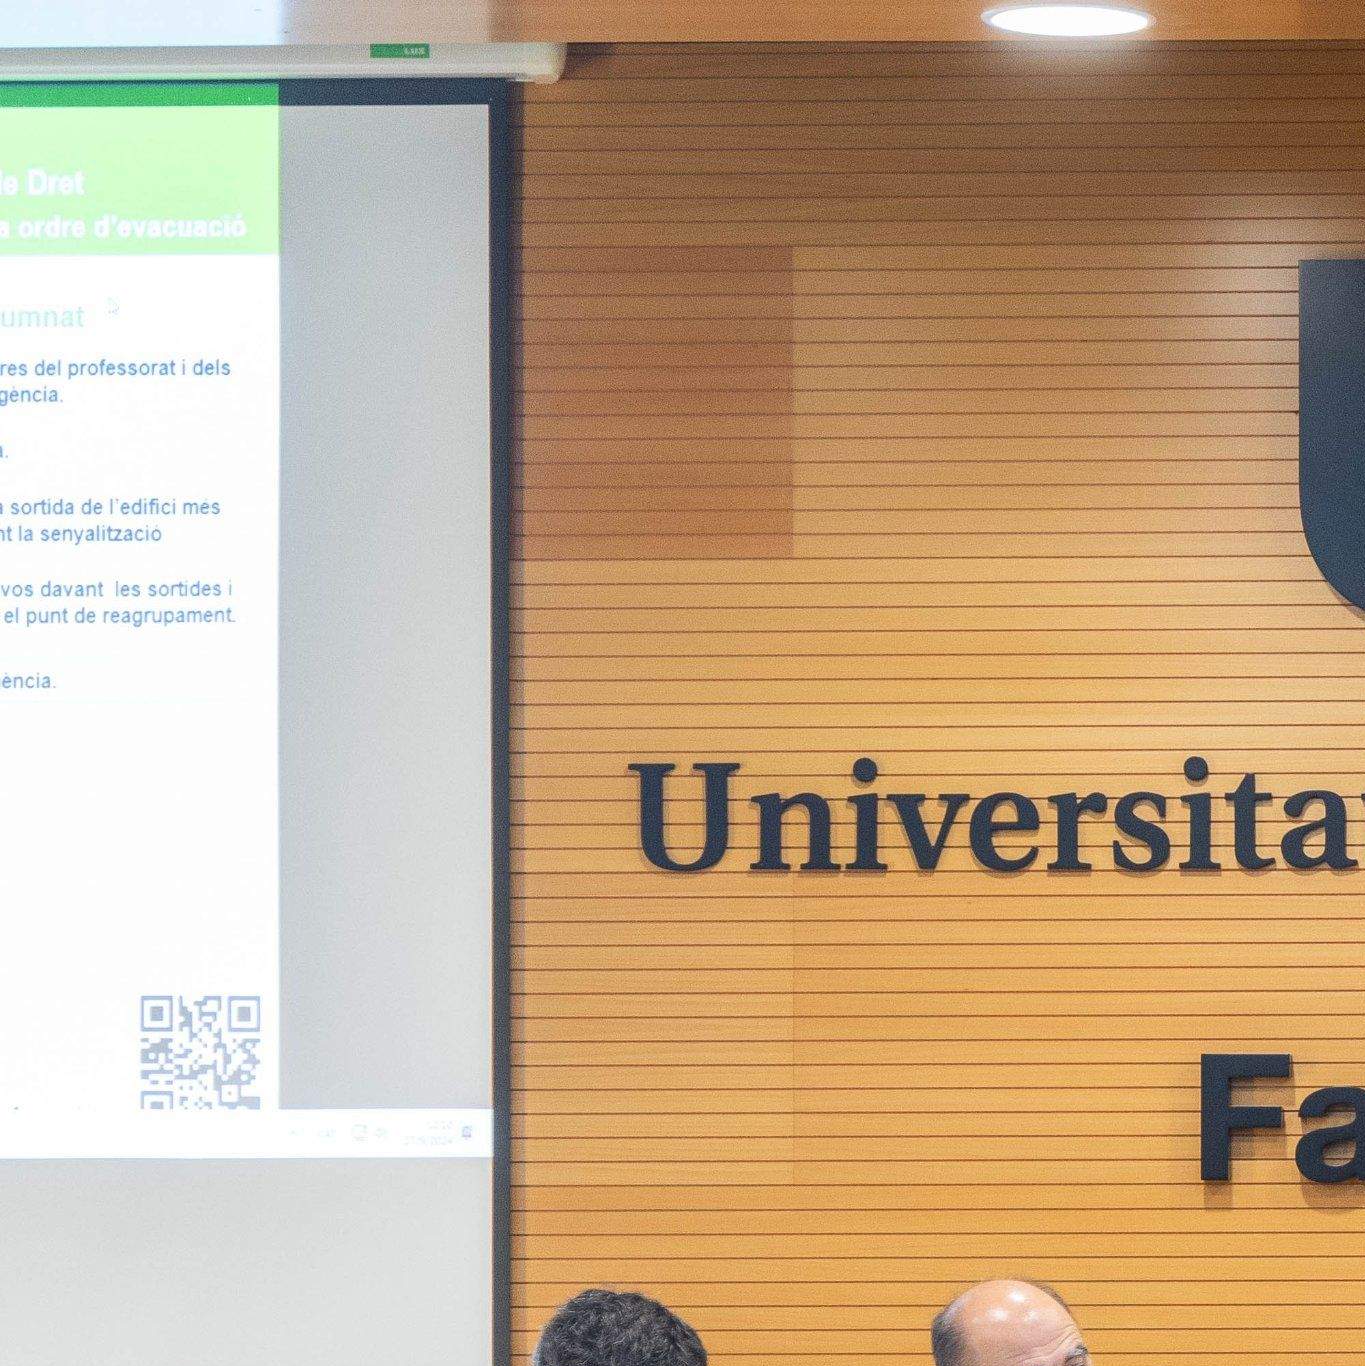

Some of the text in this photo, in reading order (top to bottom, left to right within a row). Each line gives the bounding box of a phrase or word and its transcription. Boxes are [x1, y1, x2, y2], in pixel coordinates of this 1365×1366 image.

[27, 168, 85, 197] Dret
[18, 213, 87, 239] ordre
[94, 210, 248, 239] d'evacuació
[34, 358, 62, 377] del
[67, 358, 177, 380] professorat
[192, 358, 232, 377] dels
[10, 497, 75, 516] sortida
[80, 497, 104, 516] de
[109, 497, 177, 516] l'edifici
[18, 524, 34, 542] la
[40, 523, 162, 547] senyalització
[40, 579, 104, 598] davant
[115, 579, 141, 598] les
[148, 579, 222, 598] sortides
[4, 606, 19, 623] el
[26, 607, 69, 628] punt
[74, 606, 96, 623] de
